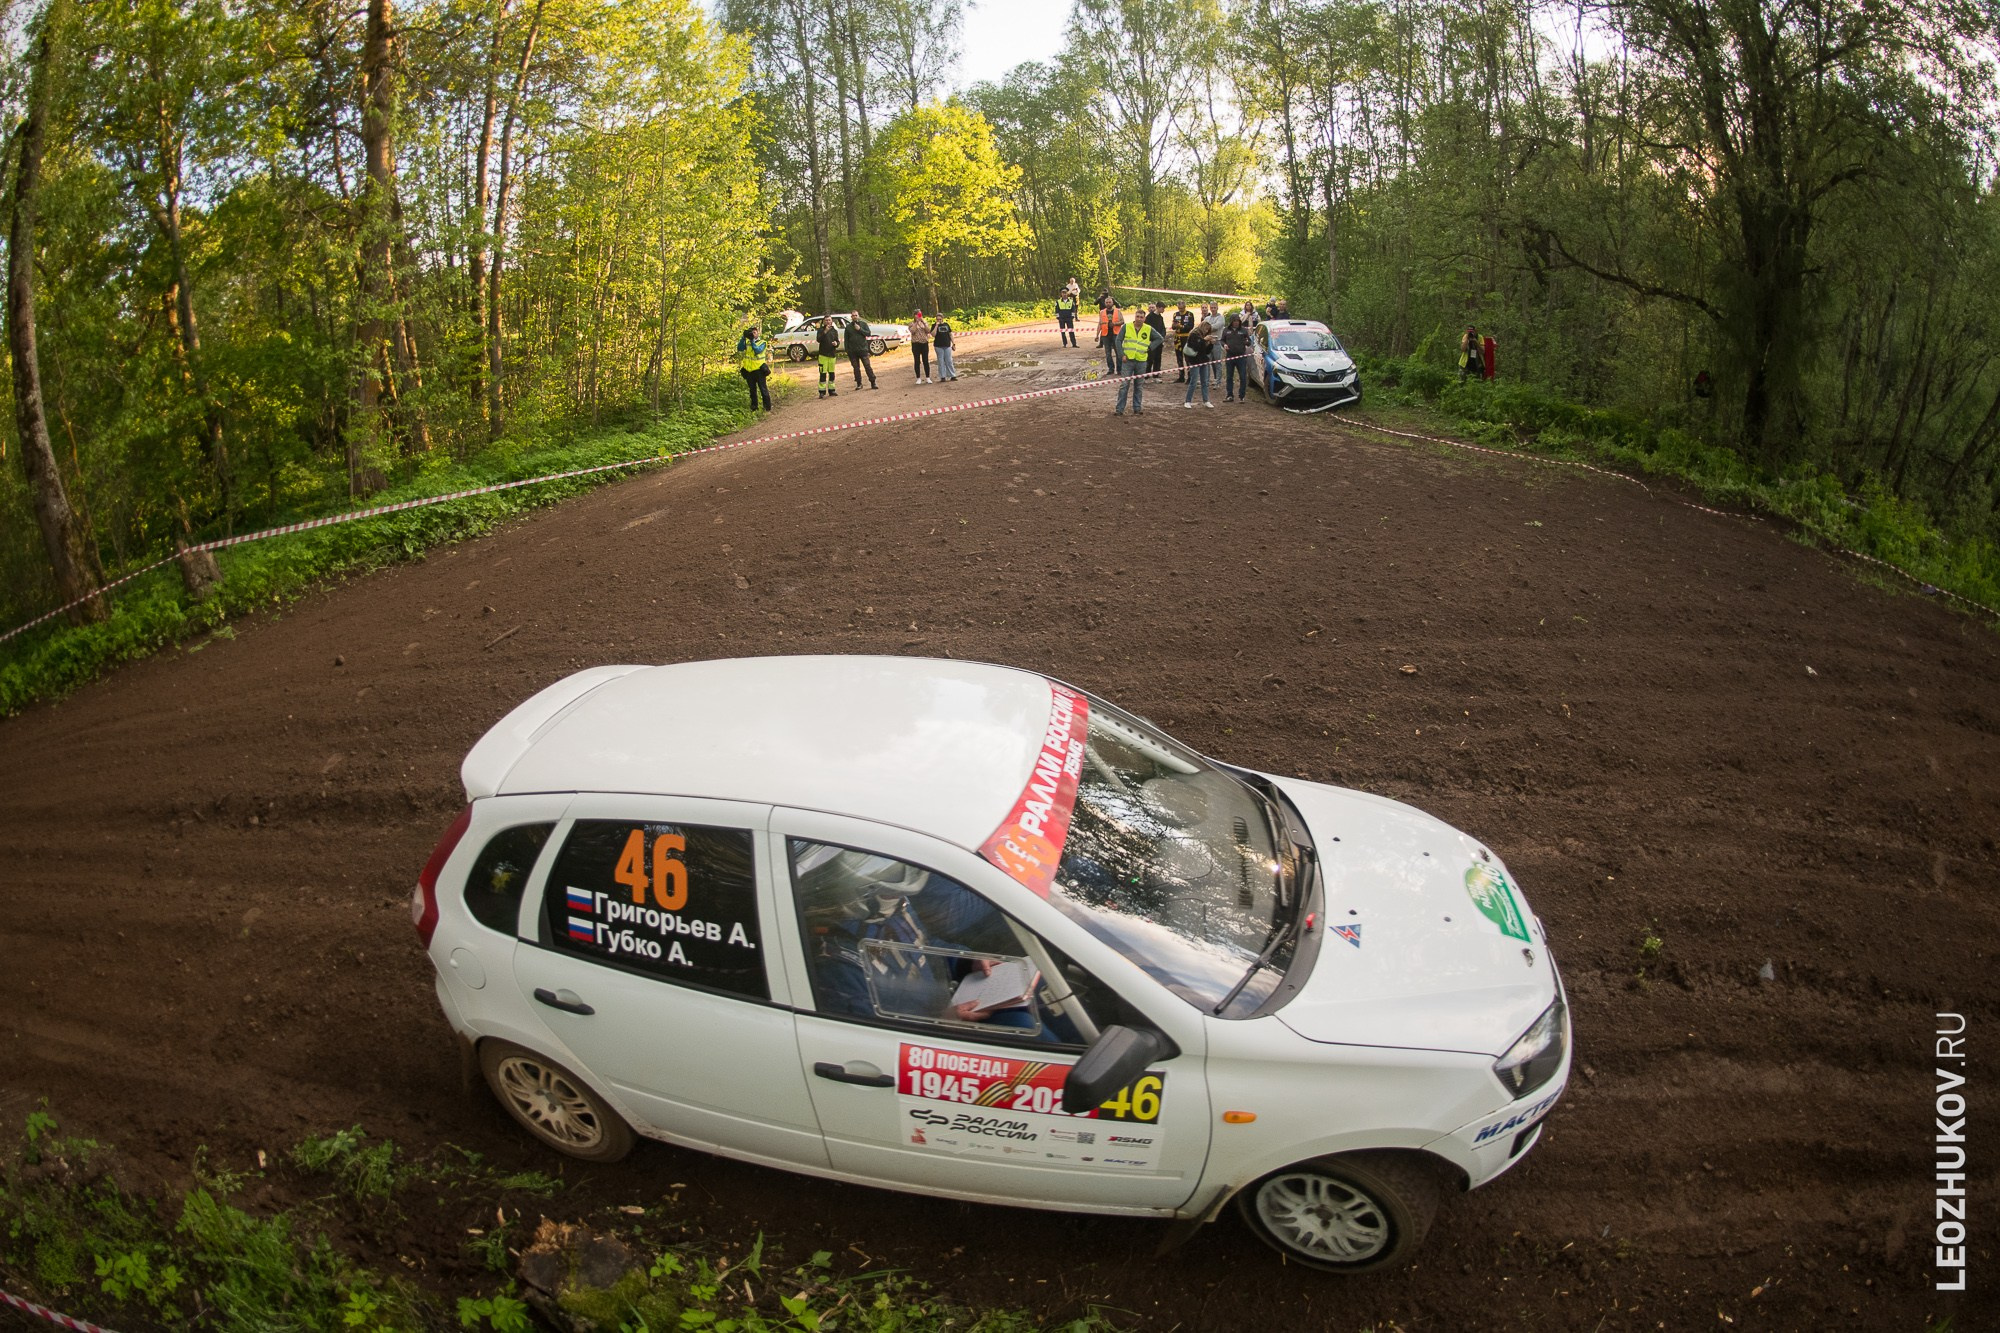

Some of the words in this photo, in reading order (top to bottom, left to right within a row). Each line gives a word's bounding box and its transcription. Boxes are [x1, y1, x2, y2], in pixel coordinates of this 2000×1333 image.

[1020, 752, 1064, 837] РАЛЛИ
[614, 829, 689, 911] 46
[595, 891, 722, 941] Григорьев
[728, 922, 756, 949] А.
[596, 922, 662, 958] Губко
[668, 941, 693, 966] А.
[908, 1046, 935, 1069] 80
[936, 1053, 1009, 1078] ПОБЕДА!
[907, 1070, 980, 1103] 1945
[1012, 1084, 1091, 1118] 202
[1100, 1076, 1162, 1120] 46
[949, 1122, 1037, 1141] РОССИИ
[954, 1114, 1029, 1130] РАЛЛИ
